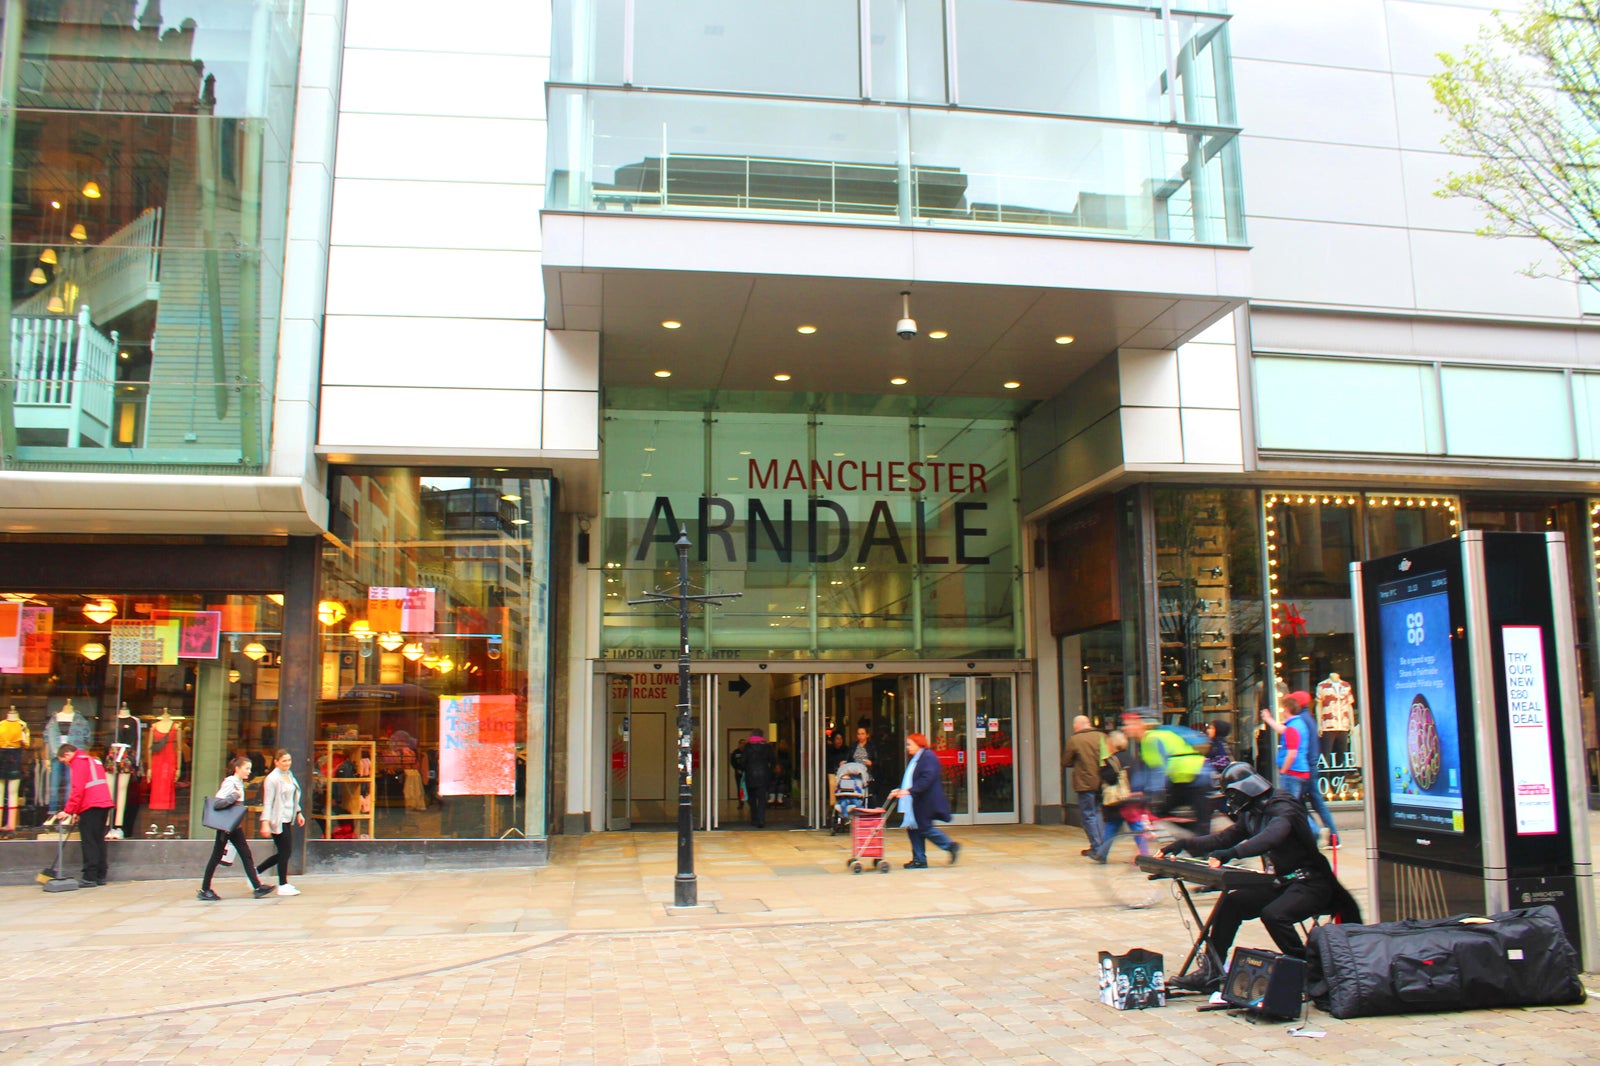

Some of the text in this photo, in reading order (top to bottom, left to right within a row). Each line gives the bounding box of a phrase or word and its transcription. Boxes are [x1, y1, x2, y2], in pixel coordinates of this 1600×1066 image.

[748, 458, 988, 494] MANCHESTER
[635, 496, 990, 565] ARNDALE
[613, 650, 665, 659] IMPROVE
[696, 650, 740, 659] CNTRE
[1507, 653, 1528, 662] TRY
[1509, 665, 1532, 675] OUR
[634, 673, 647, 685] TO
[650, 673, 679, 685] LOWE
[1510, 678, 1534, 686] NEW
[612, 688, 667, 699] STARCASE
[1511, 690, 1528, 699] £80
[447, 698, 472, 714] All
[1512, 702, 1541, 711] MEAL
[1513, 714, 1543, 724] DEAL.
[1316, 752, 1357, 768] ALE
[1318, 776, 1349, 794] 0%
